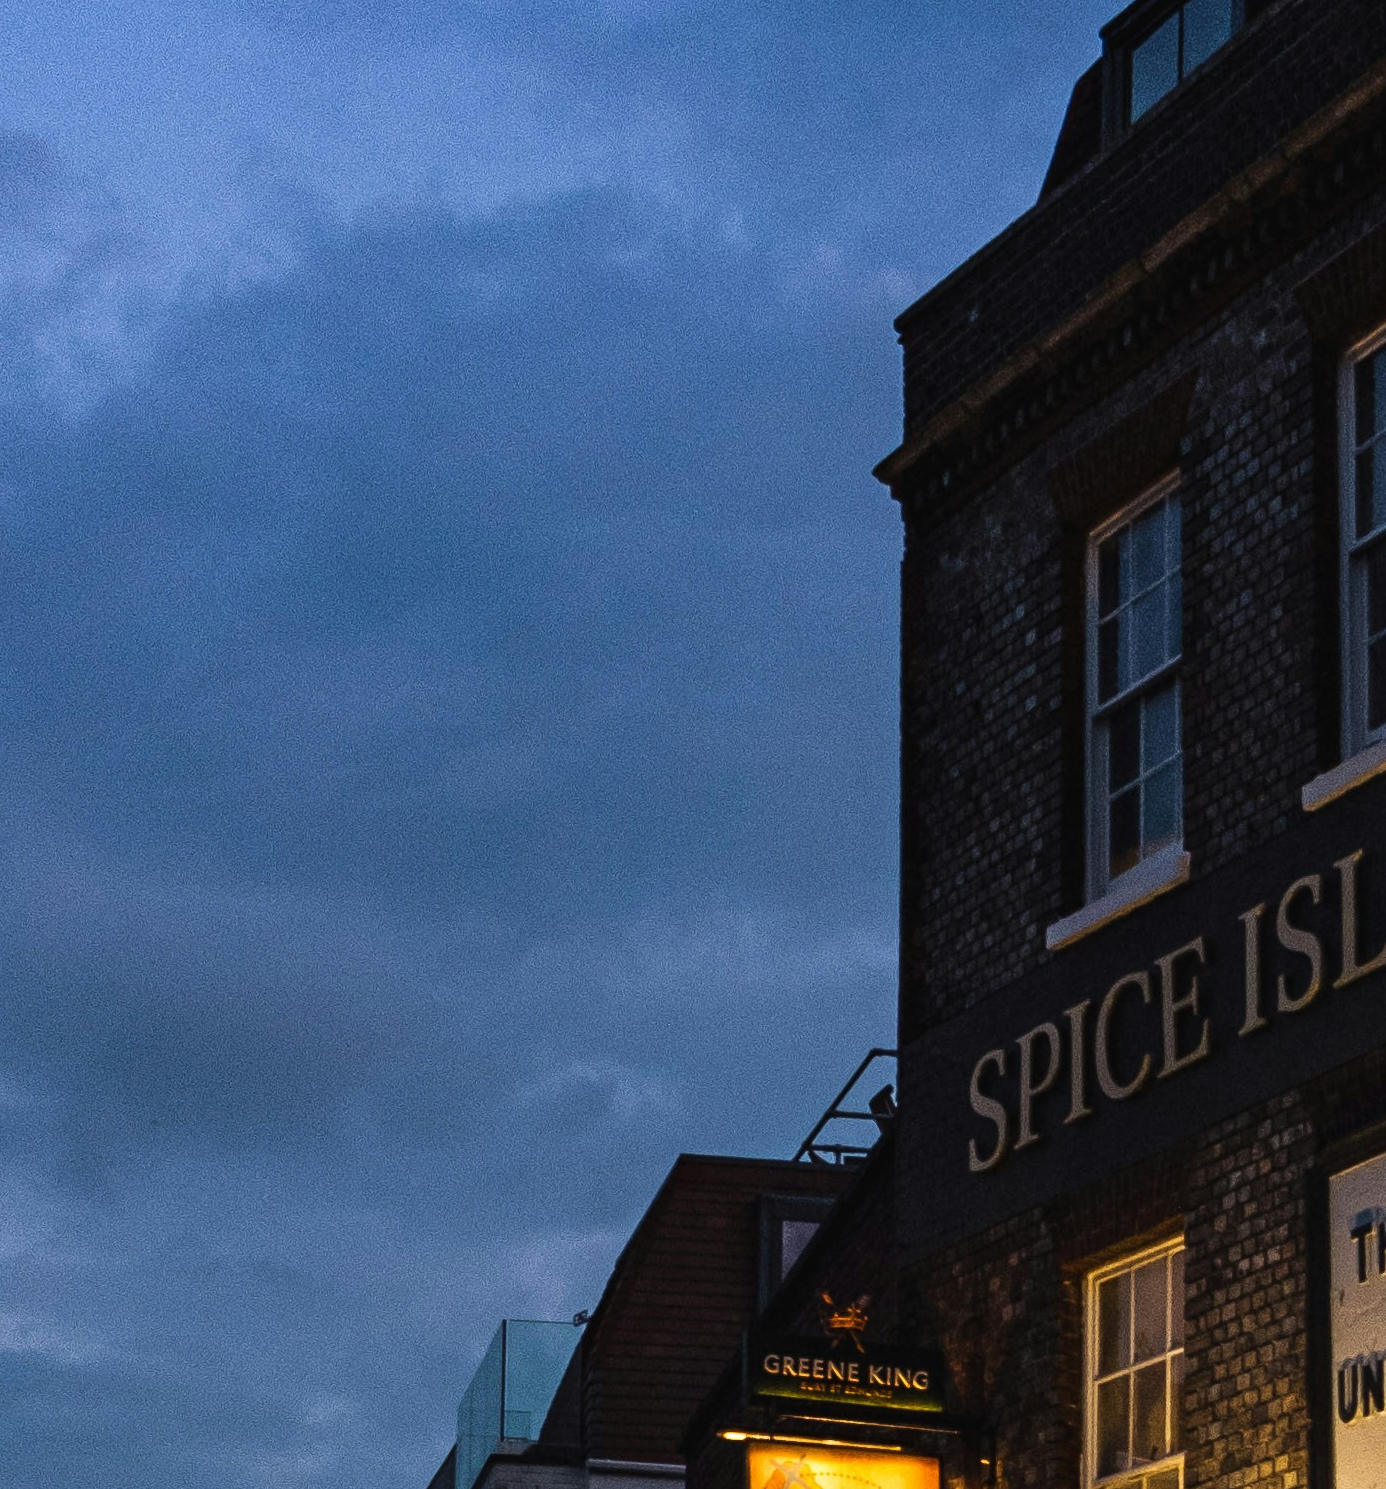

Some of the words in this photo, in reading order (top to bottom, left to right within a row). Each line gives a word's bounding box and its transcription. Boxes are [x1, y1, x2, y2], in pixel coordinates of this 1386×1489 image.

[967, 935, 1215, 1173] SPICE
[763, 1353, 861, 1383] GREENE
[868, 1363, 930, 1391] KING
